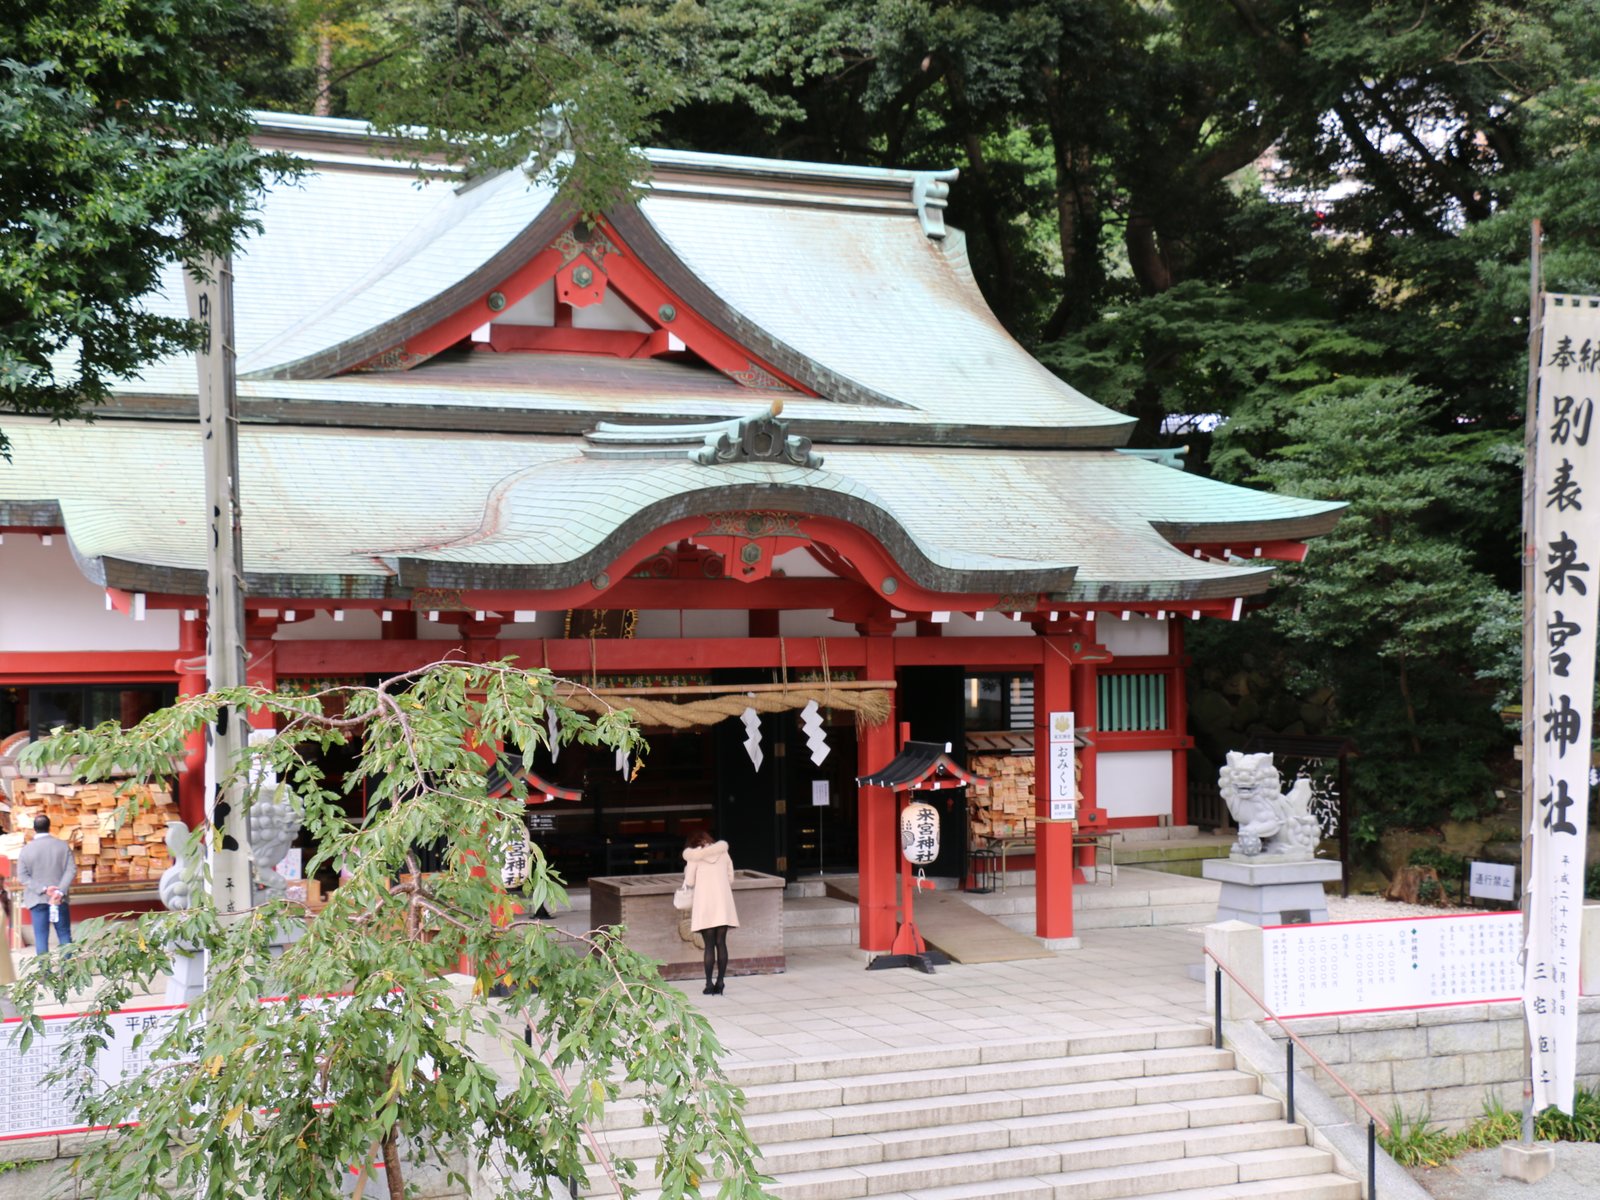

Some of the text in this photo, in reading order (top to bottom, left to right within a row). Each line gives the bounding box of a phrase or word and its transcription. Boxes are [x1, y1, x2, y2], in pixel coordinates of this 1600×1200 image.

[1539, 396, 1594, 836] 別表来宮神社
[1057, 747, 1069, 796] おみくじ
[915, 808, 935, 863] 来宮神社
